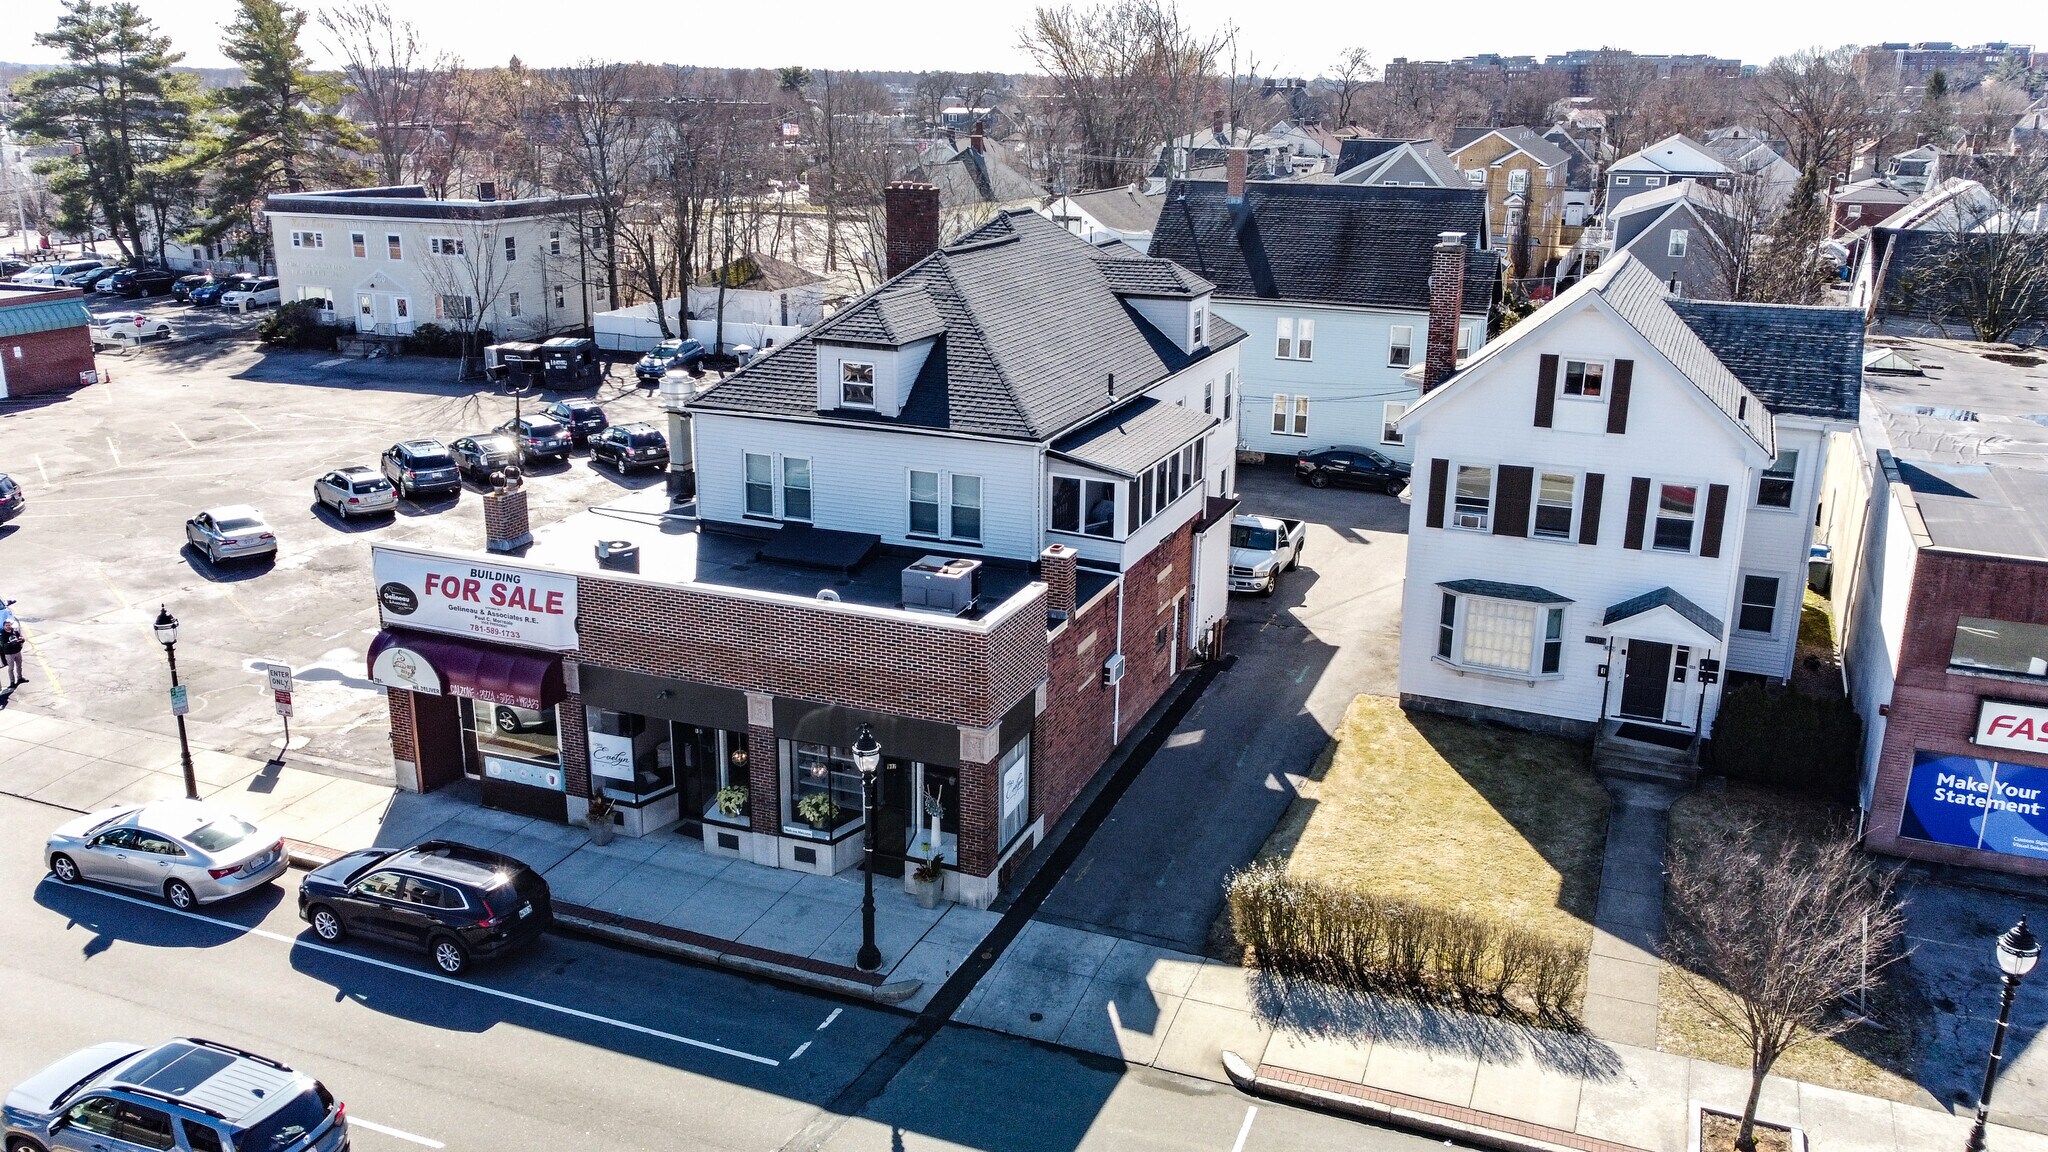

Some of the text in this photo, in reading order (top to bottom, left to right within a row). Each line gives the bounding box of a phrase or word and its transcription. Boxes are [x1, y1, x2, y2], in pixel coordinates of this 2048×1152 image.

[470, 568, 521, 584] BUILDING
[425, 573, 564, 615] FOR SALE
[448, 604, 478, 614] Gelineau
[487, 610, 523, 622] Associates
[524, 616, 539, 624] R.E.
[469, 624, 521, 639] 781-589-1733
[270, 670, 290, 679] ENTER
[271, 678, 289, 686] ONLY
[420, 685, 440, 694] DELIVER
[449, 684, 475, 698] CALZONE
[479, 689, 496, 702] PIZZA
[1936, 772, 2041, 800] Make Your
[2012, 841, 2030, 849] Visual
[2013, 836, 2035, 844] Custom
